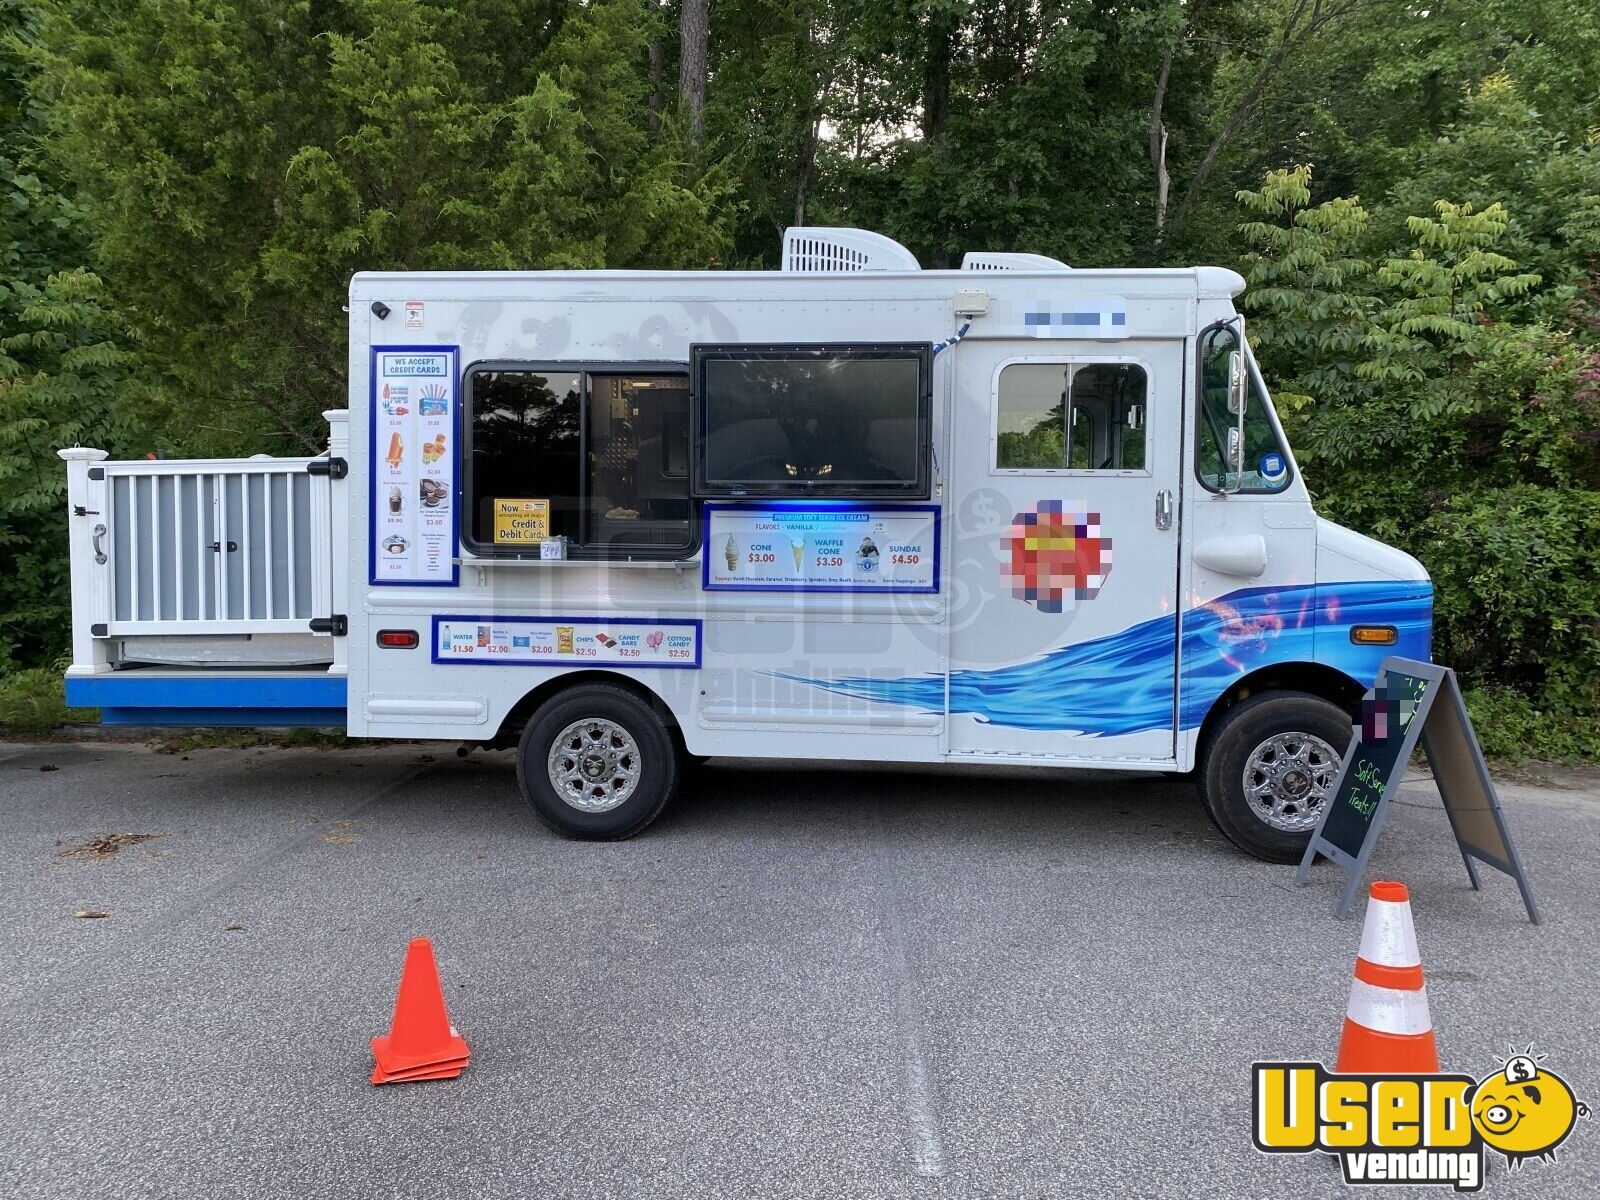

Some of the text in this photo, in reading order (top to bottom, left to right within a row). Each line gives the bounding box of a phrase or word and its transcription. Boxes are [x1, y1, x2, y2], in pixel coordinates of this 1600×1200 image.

[390, 366, 440, 374] CREDIT CARDS
[502, 504, 519, 512] Now
[512, 520, 536, 528] Credit
[500, 530, 544, 538] Debit Cards
[748, 553, 775, 562] $3.00
[816, 556, 843, 566] $3.50
[892, 554, 919, 564] $4.50
[532, 646, 552, 654] $2.00
[576, 648, 596, 656] $2.50
[620, 648, 640, 656] $2.50
[668, 650, 690, 658] $2.50
[1354, 759, 1373, 785] Soft
